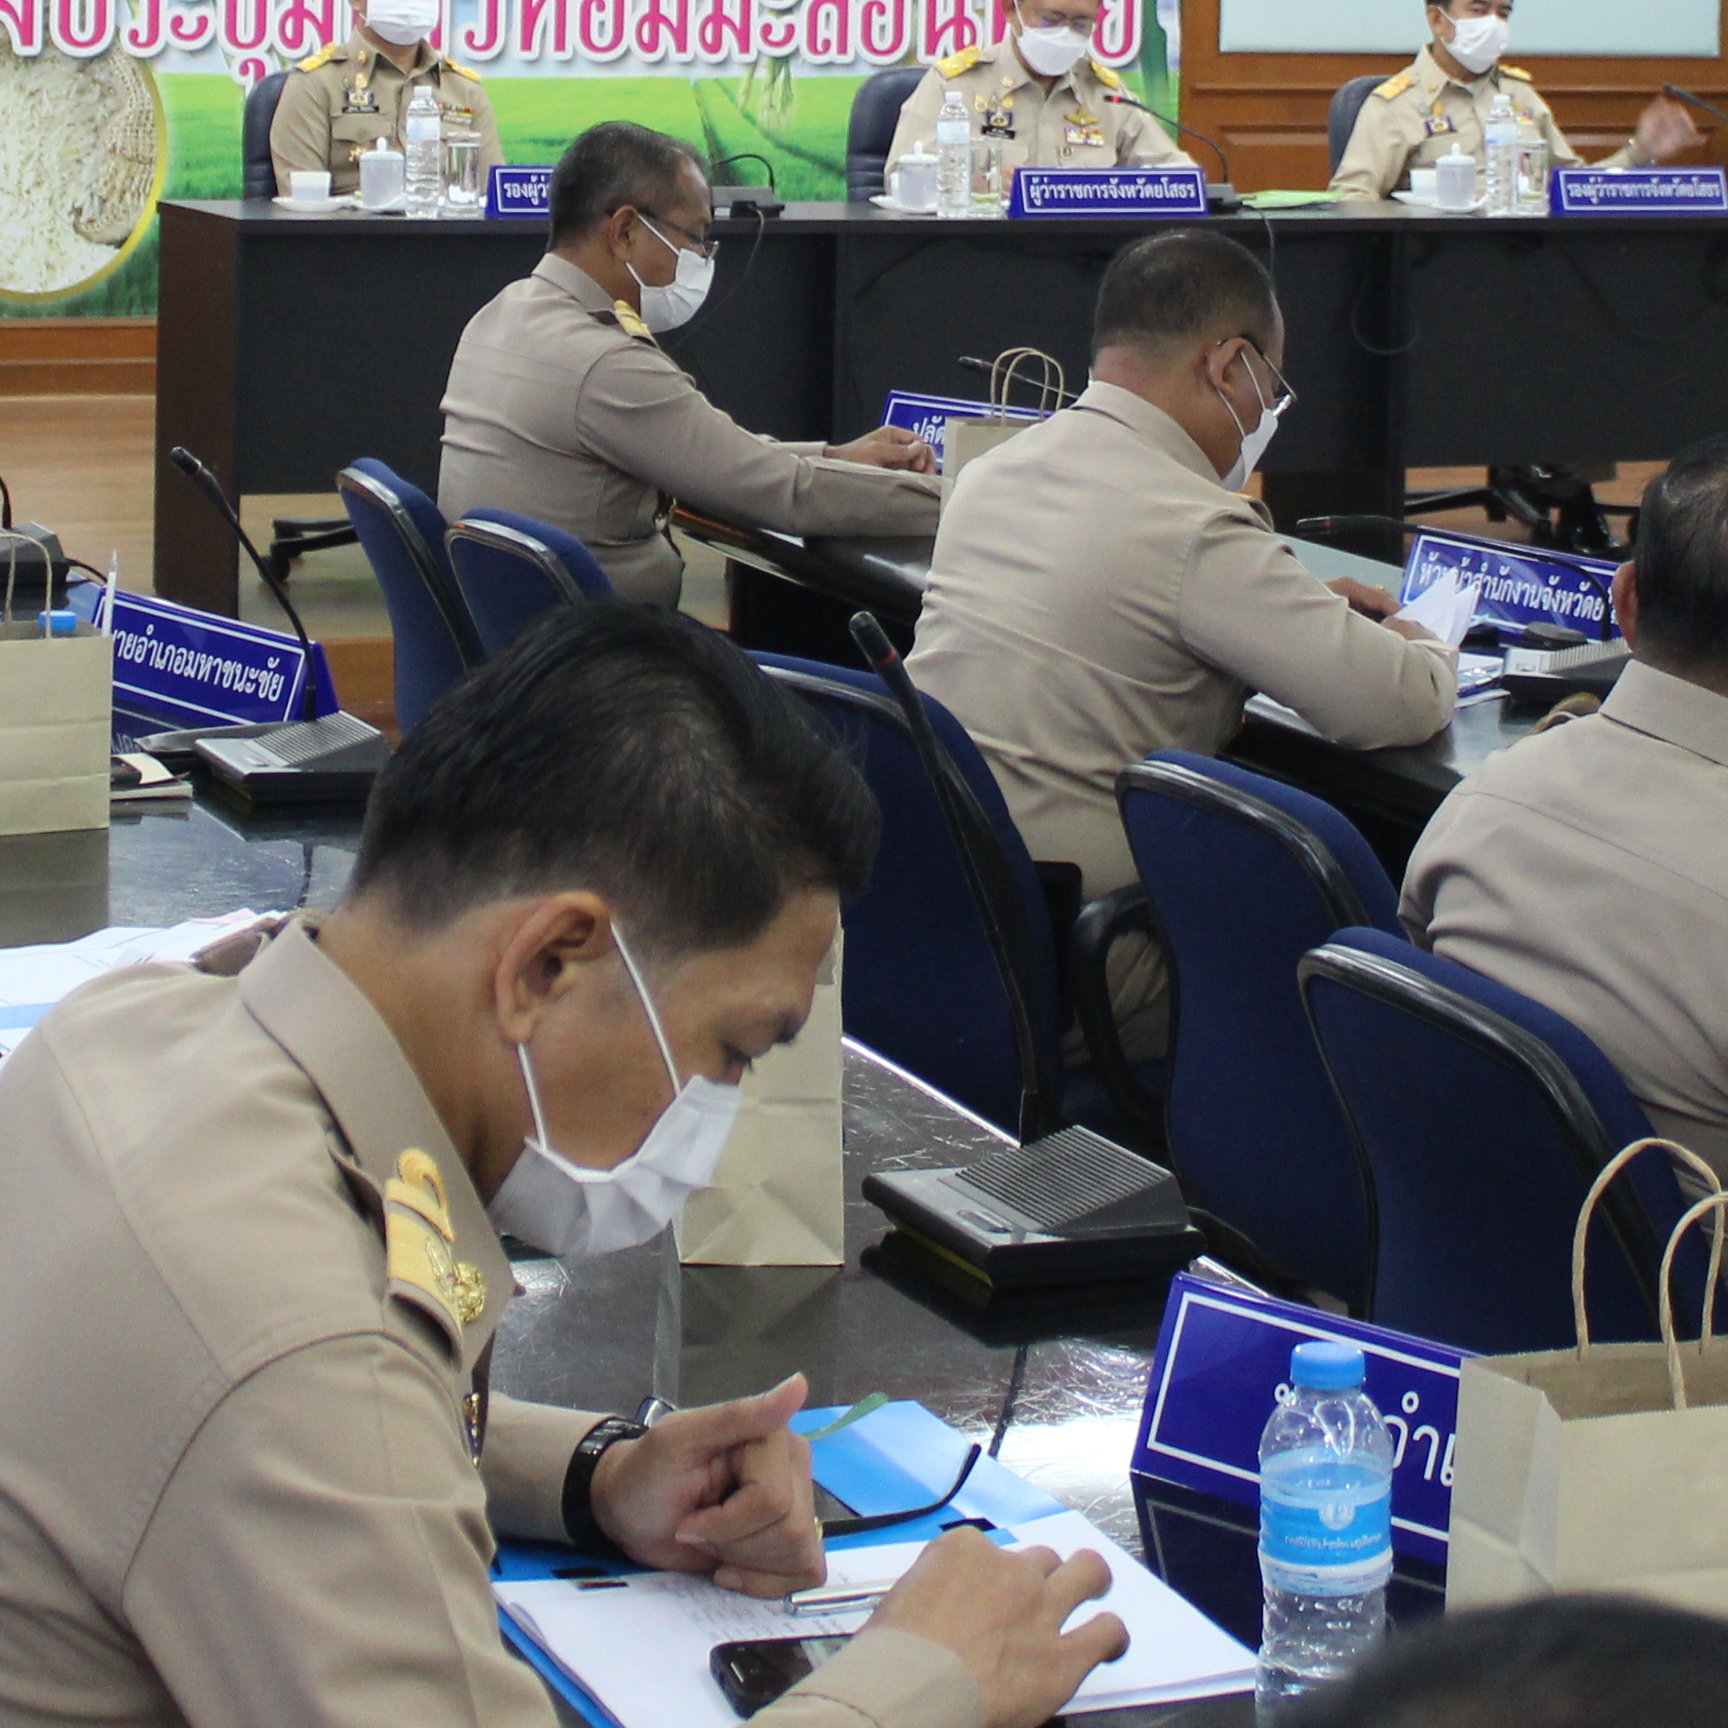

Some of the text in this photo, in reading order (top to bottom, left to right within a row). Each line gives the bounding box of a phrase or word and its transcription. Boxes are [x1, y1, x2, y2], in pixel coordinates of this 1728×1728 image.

[1029, 176, 1196, 207] ผู้ว่าราชการจังหวัดยโสธร
